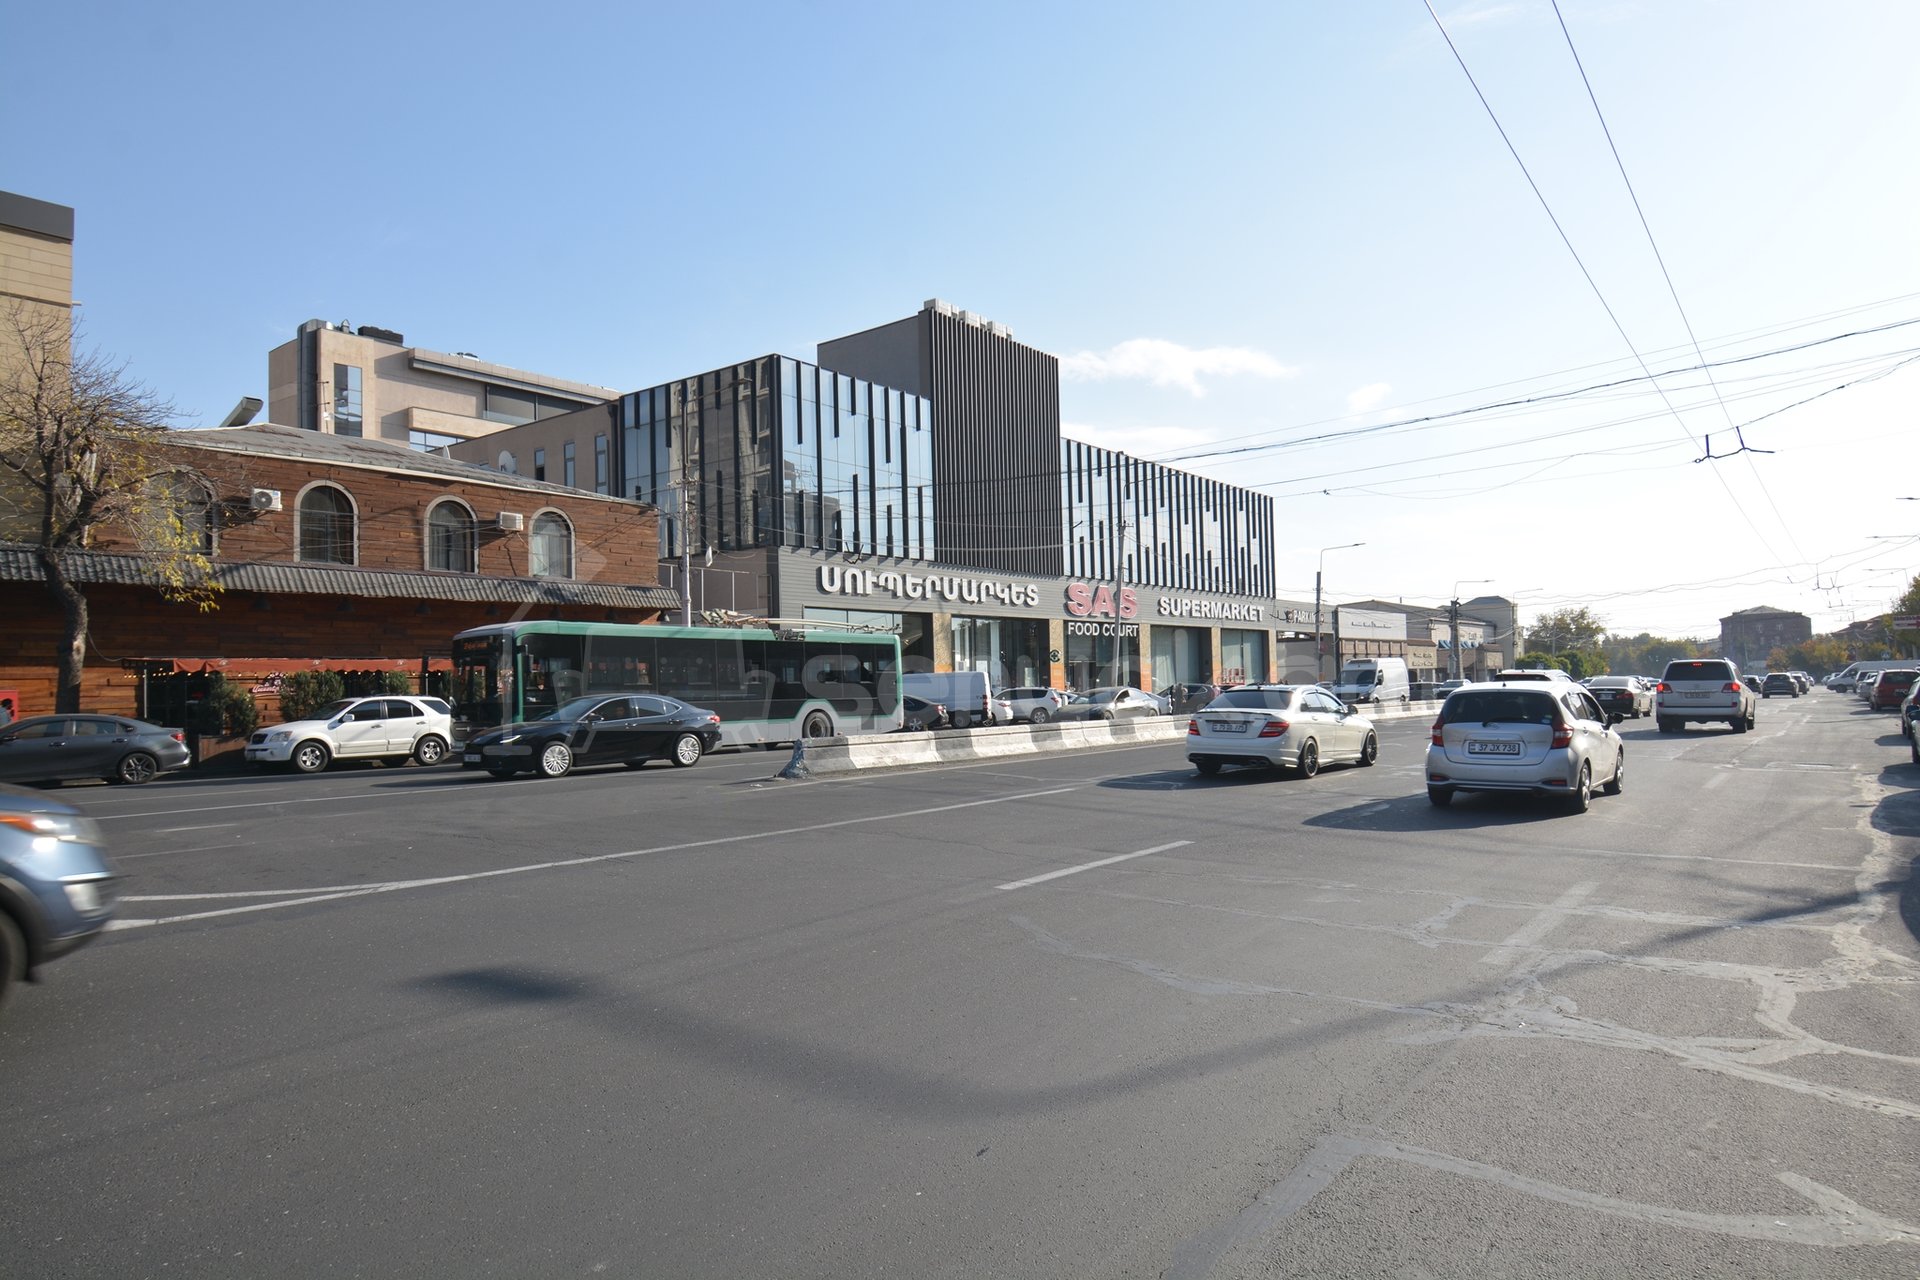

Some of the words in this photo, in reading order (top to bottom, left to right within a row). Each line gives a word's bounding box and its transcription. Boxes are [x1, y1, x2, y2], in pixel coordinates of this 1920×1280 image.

[820, 565, 1039, 607] ՍՈՒՊԵՐՄԱՐԿԵՏ
[1067, 582, 1138, 619] SAS
[1159, 595, 1265, 622] SUPERMARKET
[1068, 622, 1100, 636] FOOD
